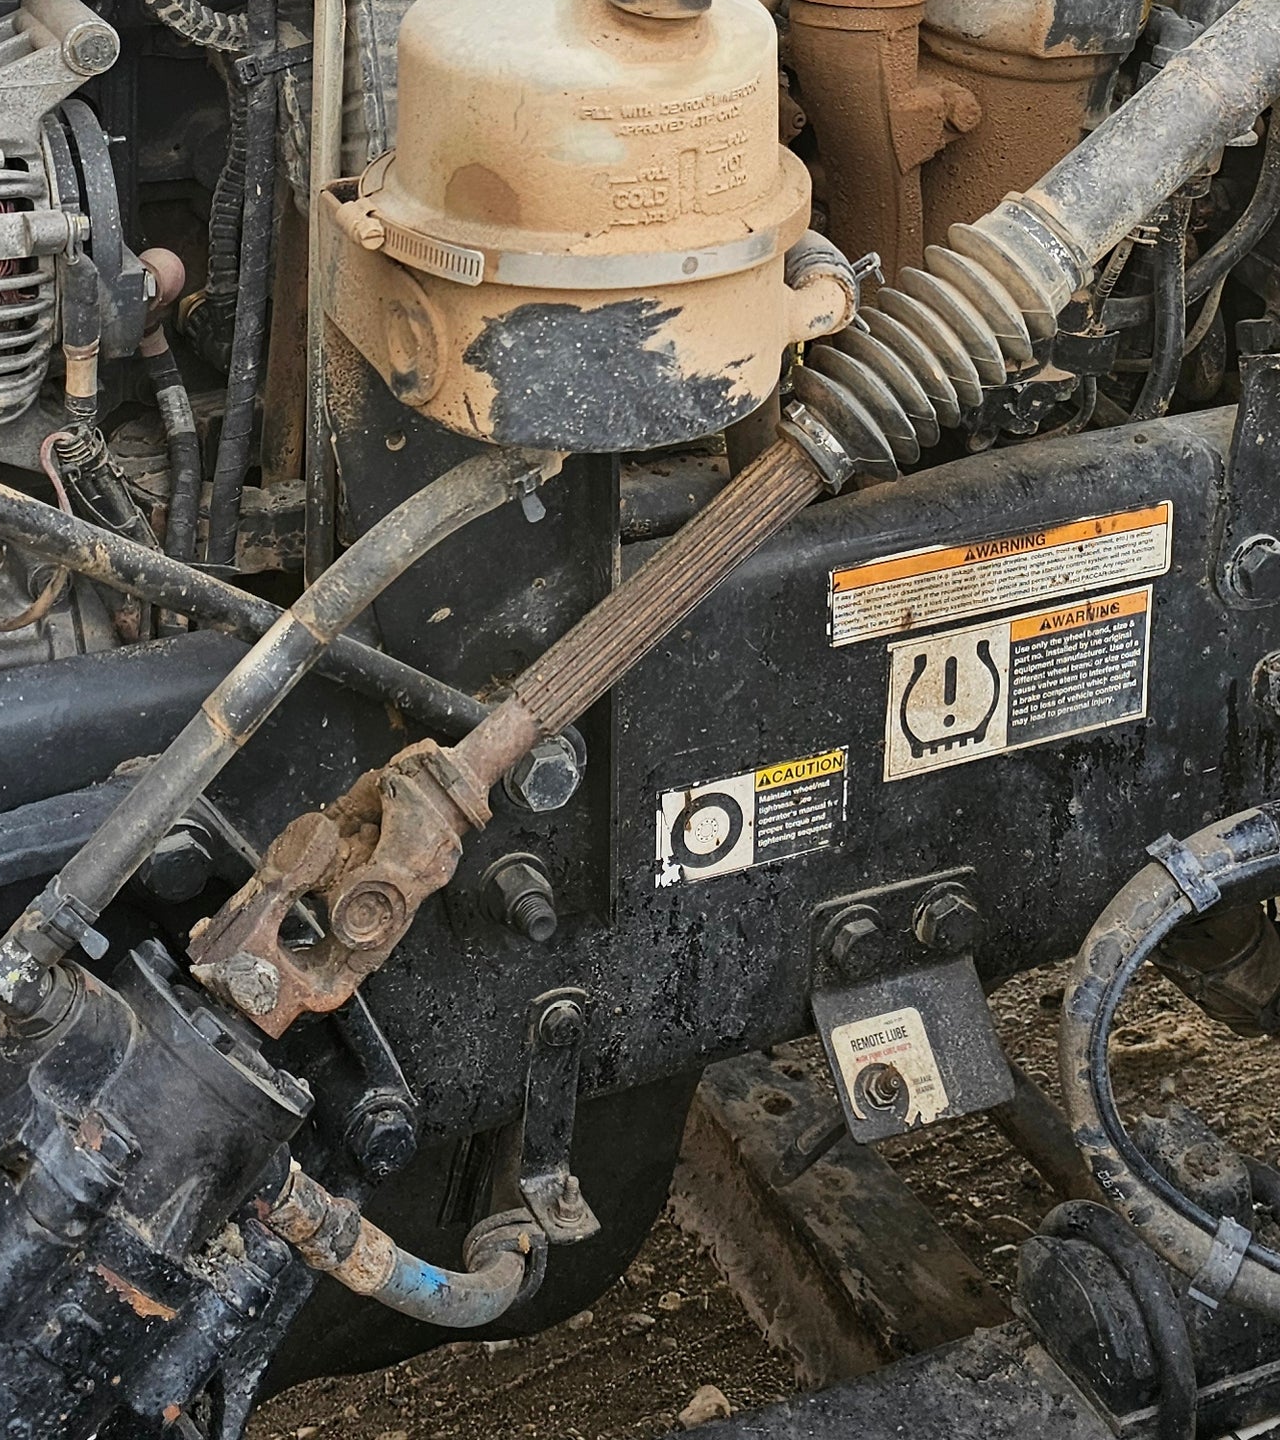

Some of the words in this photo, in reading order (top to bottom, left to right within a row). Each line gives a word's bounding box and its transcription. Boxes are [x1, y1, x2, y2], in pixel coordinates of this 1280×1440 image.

[612, 187, 669, 210] COLD
[976, 532, 1045, 558] WARNING
[1052, 601, 1120, 629] WARNING
[1014, 645, 1029, 654] Use
[1031, 640, 1047, 650] only
[1049, 637, 1061, 646] the
[1063, 630, 1085, 642] wheel
[1087, 624, 1111, 637] brand,
[1113, 622, 1127, 630] size
[1129, 618, 1134, 627] &
[1014, 654, 1029, 666] part
[1079, 641, 1087, 649] by
[1103, 629, 1131, 642] original
[1013, 658, 1054, 675] equipment
[1055, 647, 1107, 665] manufacturer.
[1109, 643, 1123, 652] Use
[1125, 639, 1133, 648] of
[1013, 670, 1045, 685] different
[1047, 665, 1069, 677] wheel
[1104, 654, 1118, 663] size
[1120, 647, 1140, 659] could
[1013, 685, 1036, 695] cause
[1037, 679, 1057, 689] valve
[1059, 675, 1077, 684] stem
[1121, 659, 1136, 669] with
[1019, 693, 1040, 704] brake
[1042, 681, 1085, 698] component
[1109, 670, 1130, 682] could
[1012, 705, 1028, 716] lead
[1040, 700, 1055, 709] loss
[1057, 696, 1065, 705] of
[1067, 690, 1093, 702] vehicle
[1095, 682, 1121, 696] control
[1122, 678, 1136, 689] and
[1011, 717, 1027, 726] may
[1030, 711, 1045, 721] lead
[1057, 700, 1089, 716] personal
[772, 754, 842, 783] CAUTION
[758, 789, 791, 803] Maintain
[757, 824, 783, 837] proper
[784, 817, 809, 829] torque
[811, 812, 825, 822] and
[758, 809, 797, 824] operator's
[798, 801, 826, 814] manual
[757, 832, 795, 847] tightening
[850, 1033, 885, 1052] REMOTE
[886, 1025, 909, 1042] LUBE
